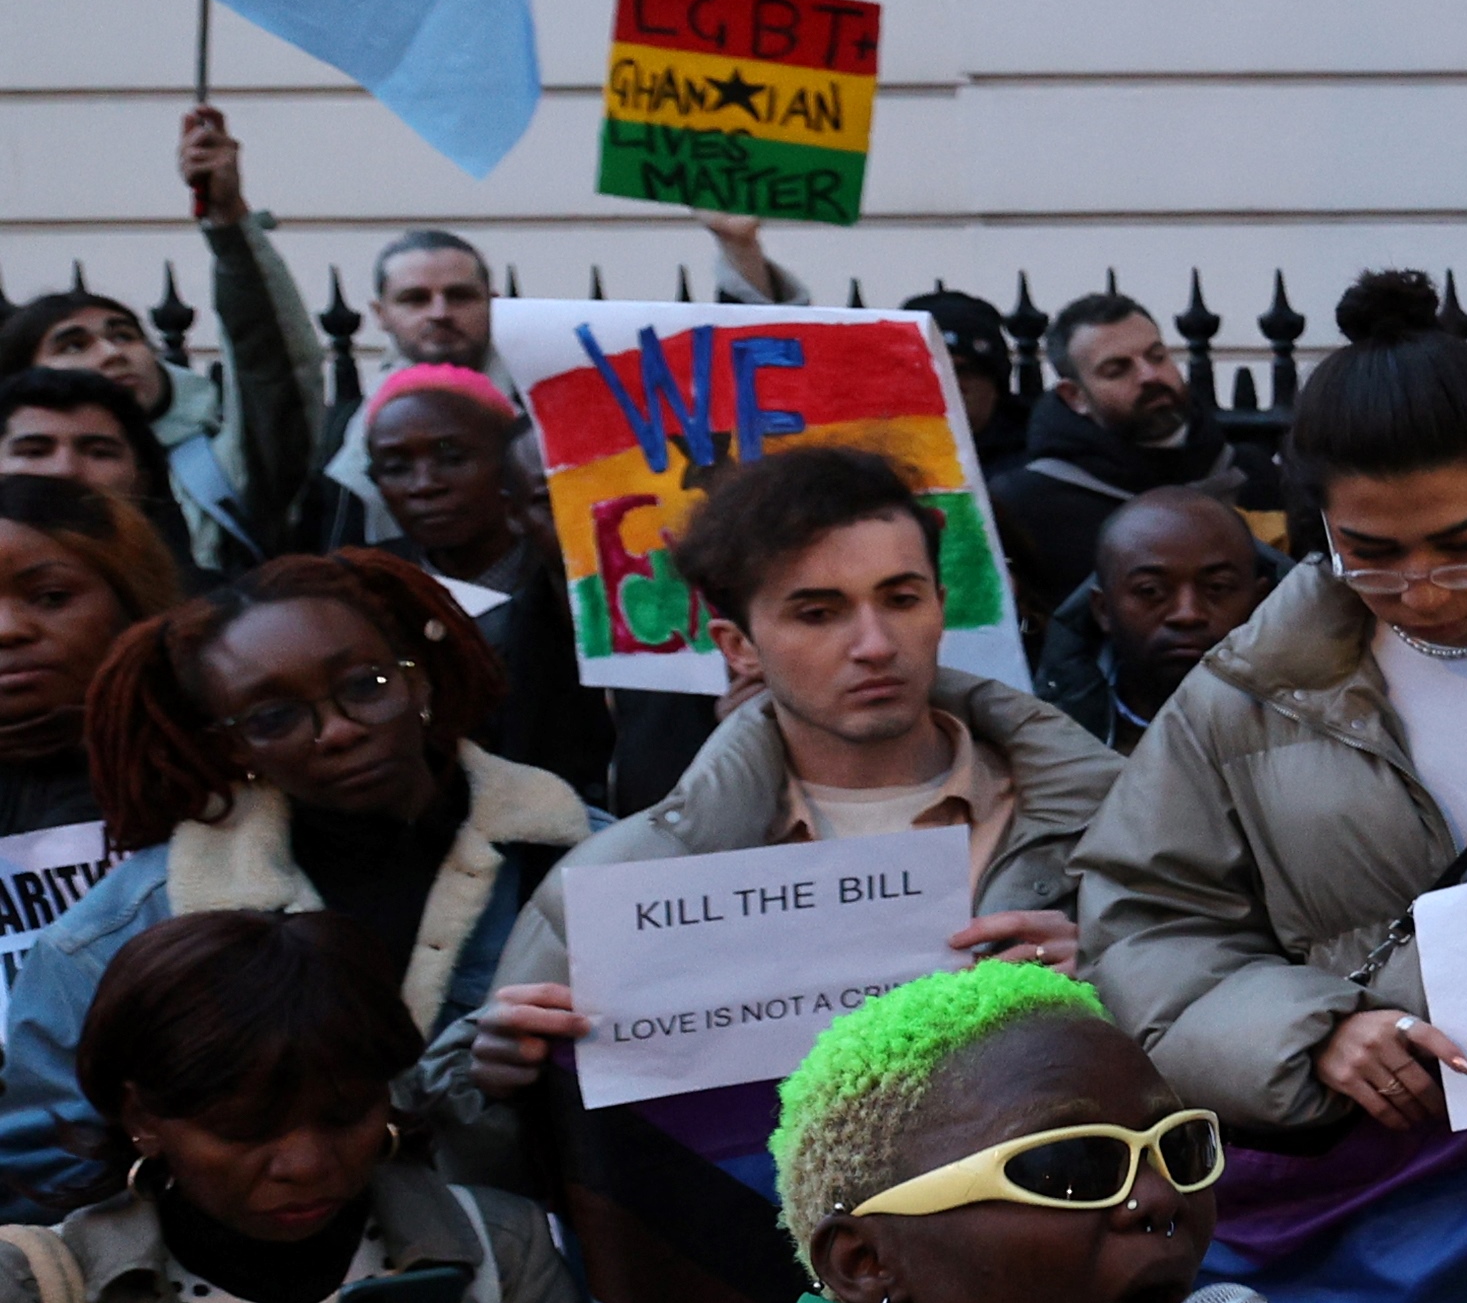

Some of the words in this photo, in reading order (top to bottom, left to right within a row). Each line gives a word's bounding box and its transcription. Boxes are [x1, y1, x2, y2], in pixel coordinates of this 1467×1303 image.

[608, 114, 750, 163] LIVES
[641, 160, 850, 221] MATTER
[635, 900, 725, 931] KILL
[733, 882, 815, 917] THE
[838, 870, 923, 905] BILL
[613, 1011, 697, 1043] LOVE
[705, 1006, 732, 1030] IS
[740, 995, 804, 1025] NOT
[812, 992, 833, 1014] A
